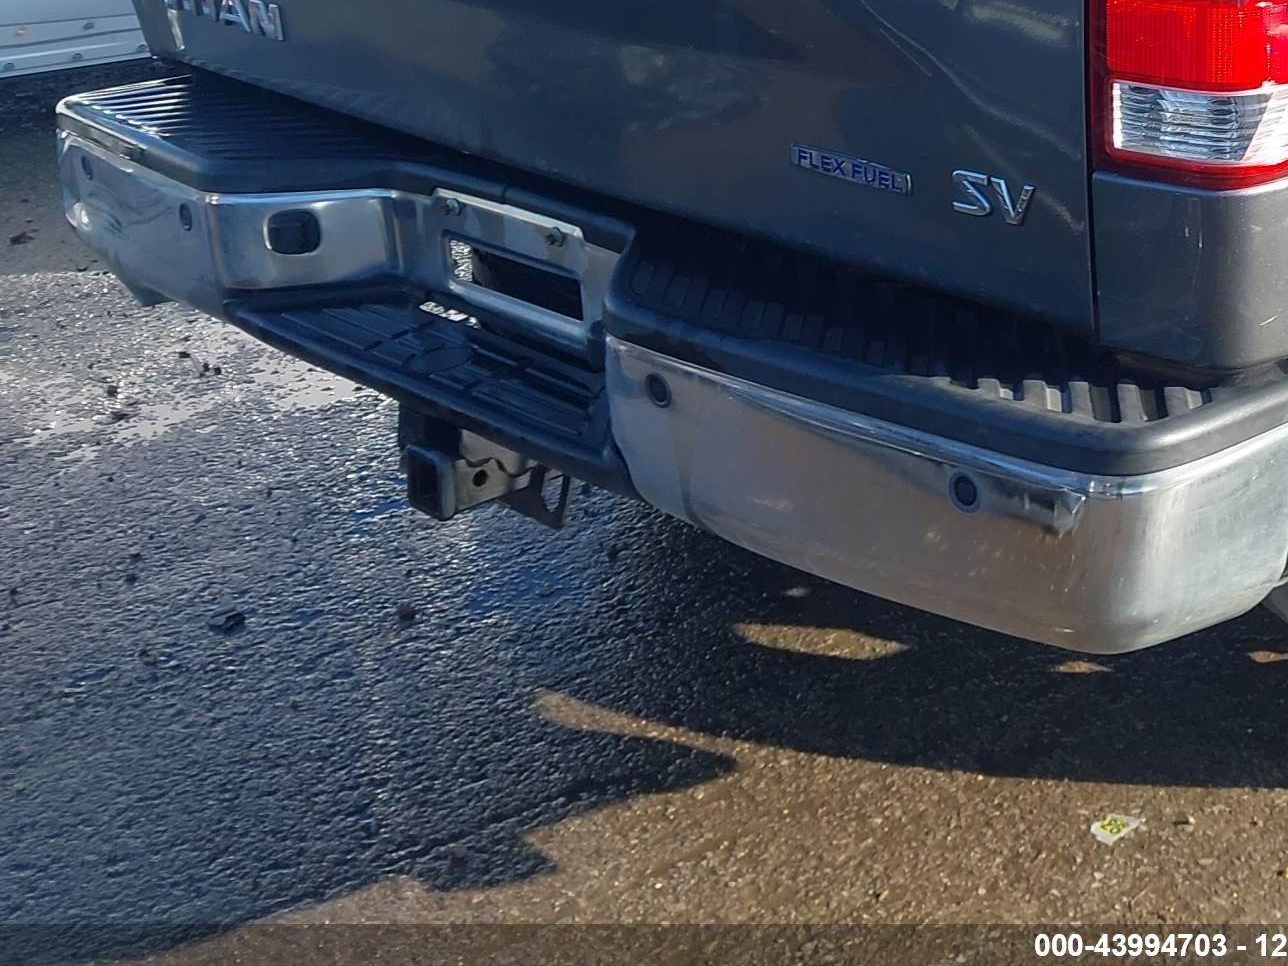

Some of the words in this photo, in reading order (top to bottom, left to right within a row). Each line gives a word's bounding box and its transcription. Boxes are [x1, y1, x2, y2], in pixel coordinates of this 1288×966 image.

[797, 148, 846, 177] FLEX
[851, 162, 904, 192] FUEL
[952, 169, 1036, 225] SV
